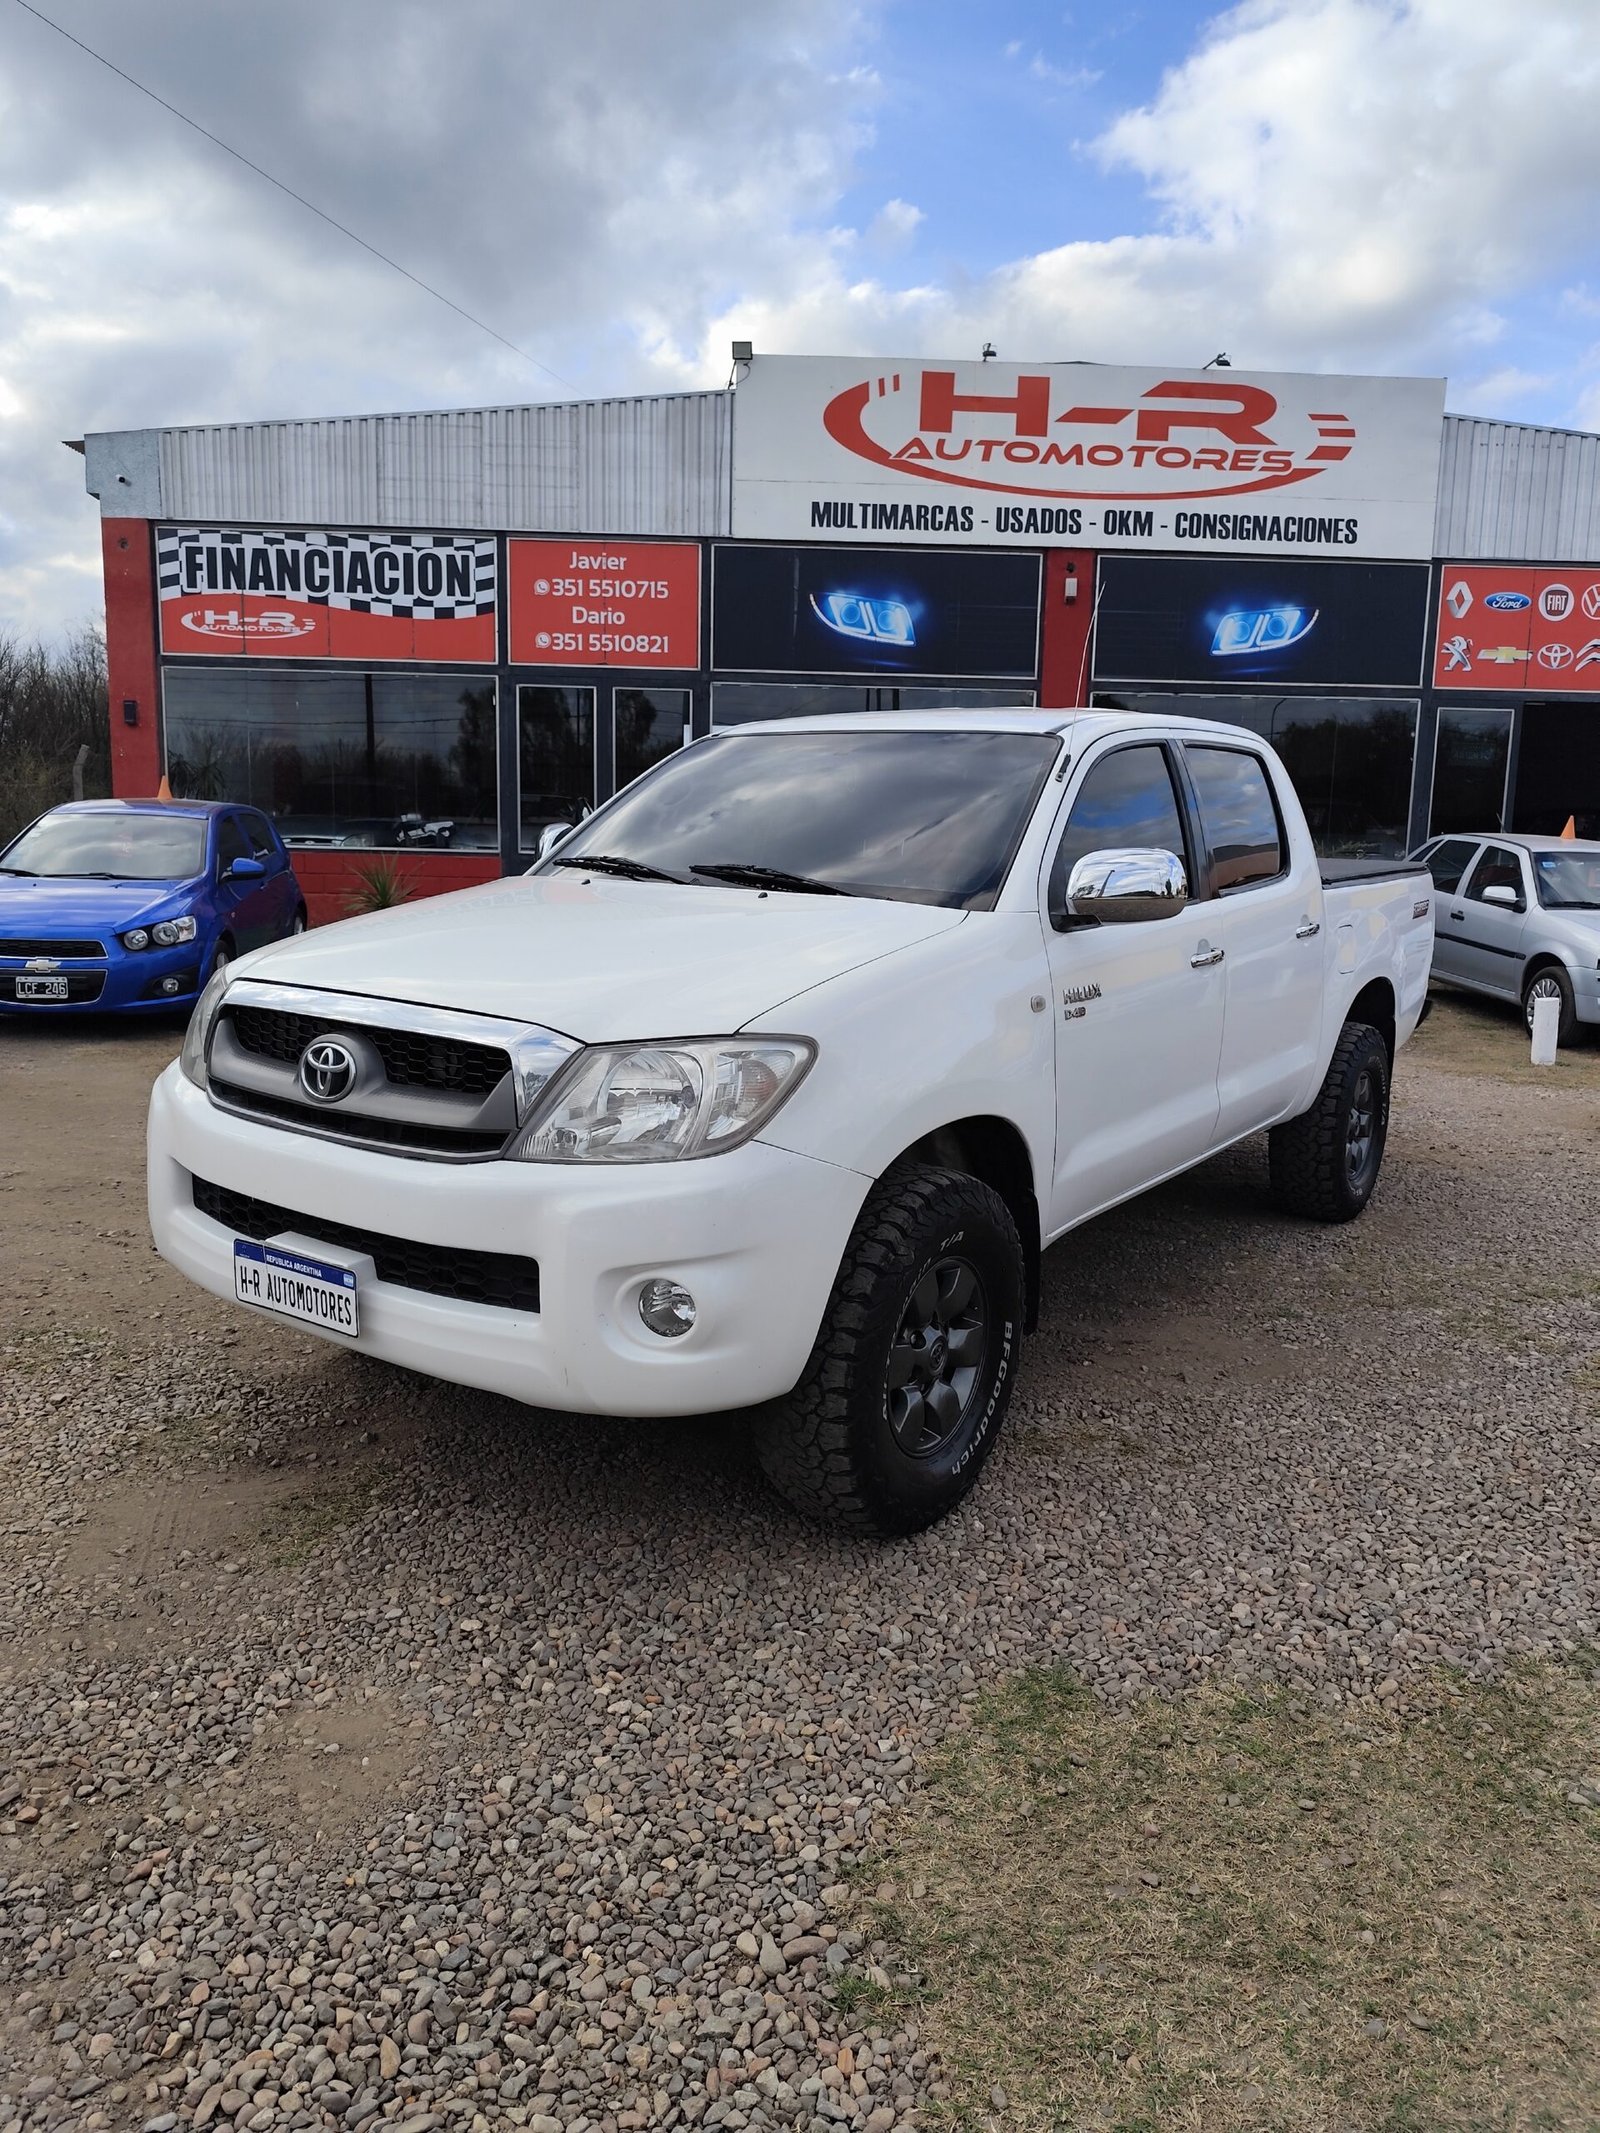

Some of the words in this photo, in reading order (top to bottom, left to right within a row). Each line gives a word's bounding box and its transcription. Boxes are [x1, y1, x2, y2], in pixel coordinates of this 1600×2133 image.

[919, 370, 1278, 446] H-R
[892, 437, 1295, 473] AUTOMOTORES
[811, 501, 974, 531] MULTIMARCAS
[995, 506, 1081, 534] USADOS
[1174, 512, 1357, 544] CONSIGNACIONES
[569, 551, 627, 570] Javier
[184, 545, 471, 598] FINANCIACION
[551, 578, 583, 596] 351
[589, 579, 669, 599] 5510715
[1492, 595, 1523, 609] Ford
[1547, 594, 1567, 611] FIAT
[204, 609, 297, 627] H-R
[572, 606, 626, 625] Dario
[199, 624, 302, 633] AUTOMOTORES
[551, 633, 583, 651] 351
[589, 633, 669, 653] 5510821
[18, 982, 38, 994] LCF
[45, 982, 66, 995] 246
[940, 1230, 965, 1252] T/A
[293, 1263, 322, 1277] ARGENTINA
[240, 1265, 261, 1298] H-R
[267, 1273, 352, 1326] AUTOMOTORES
[951, 1321, 1013, 1475] BFGoodrich
